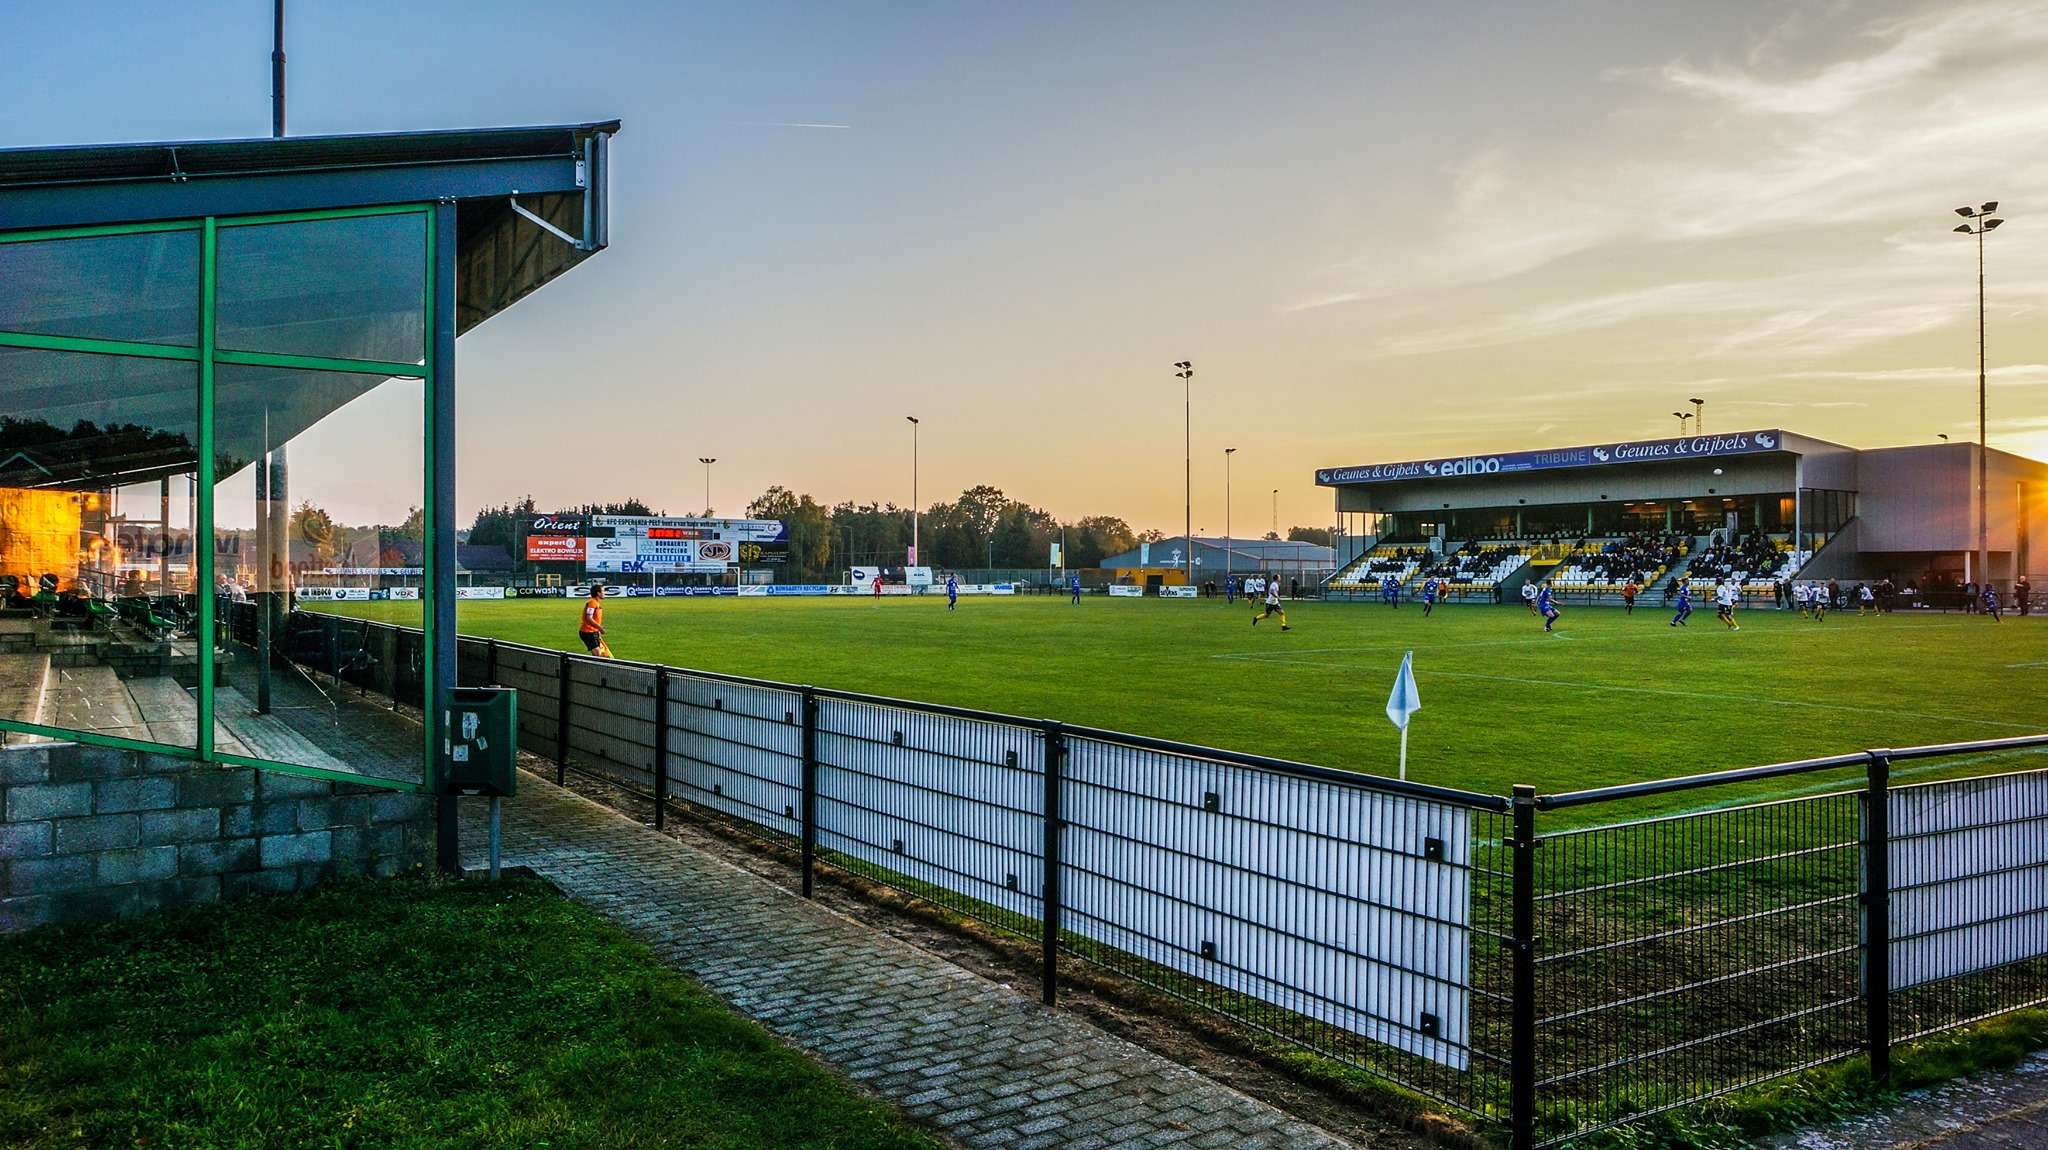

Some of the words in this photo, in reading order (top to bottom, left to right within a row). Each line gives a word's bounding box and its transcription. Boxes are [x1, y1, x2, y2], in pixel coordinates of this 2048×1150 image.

[1615, 443, 1669, 459] Geunes
[1674, 438, 1687, 454] &
[1691, 435, 1748, 457] Gijbels
[1535, 451, 1586, 465] TRIBUNE
[1333, 469, 1370, 480] Geunes
[1372, 466, 1380, 477] &
[1383, 463, 1420, 479] Gijbels
[1441, 457, 1500, 477] edibo
[534, 517, 580, 530] Orient
